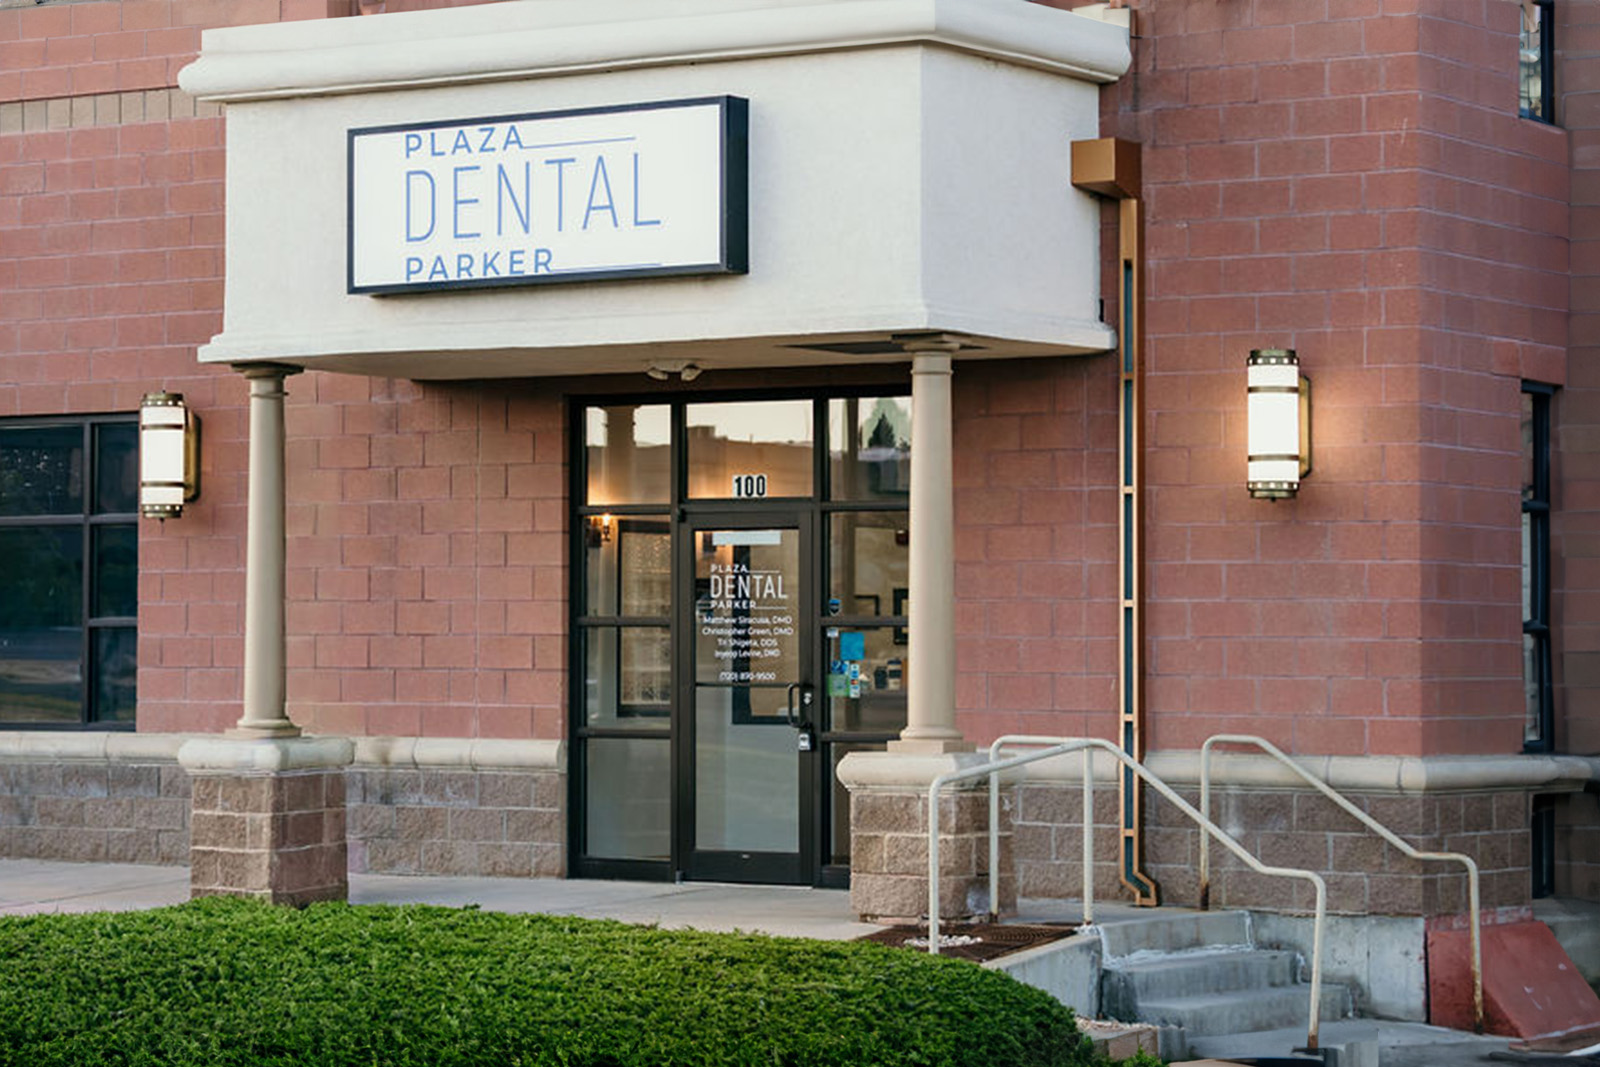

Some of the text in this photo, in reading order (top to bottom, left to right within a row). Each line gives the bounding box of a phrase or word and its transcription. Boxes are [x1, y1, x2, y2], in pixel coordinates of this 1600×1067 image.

[405, 125, 523, 159] PLAZA
[405, 152, 662, 243] DENTAL
[405, 248, 553, 283] PARKER
[733, 474, 768, 499] 100
[710, 564, 748, 574] PLAZA
[710, 575, 788, 599] DENTAL
[709, 600, 757, 610] PARKER
